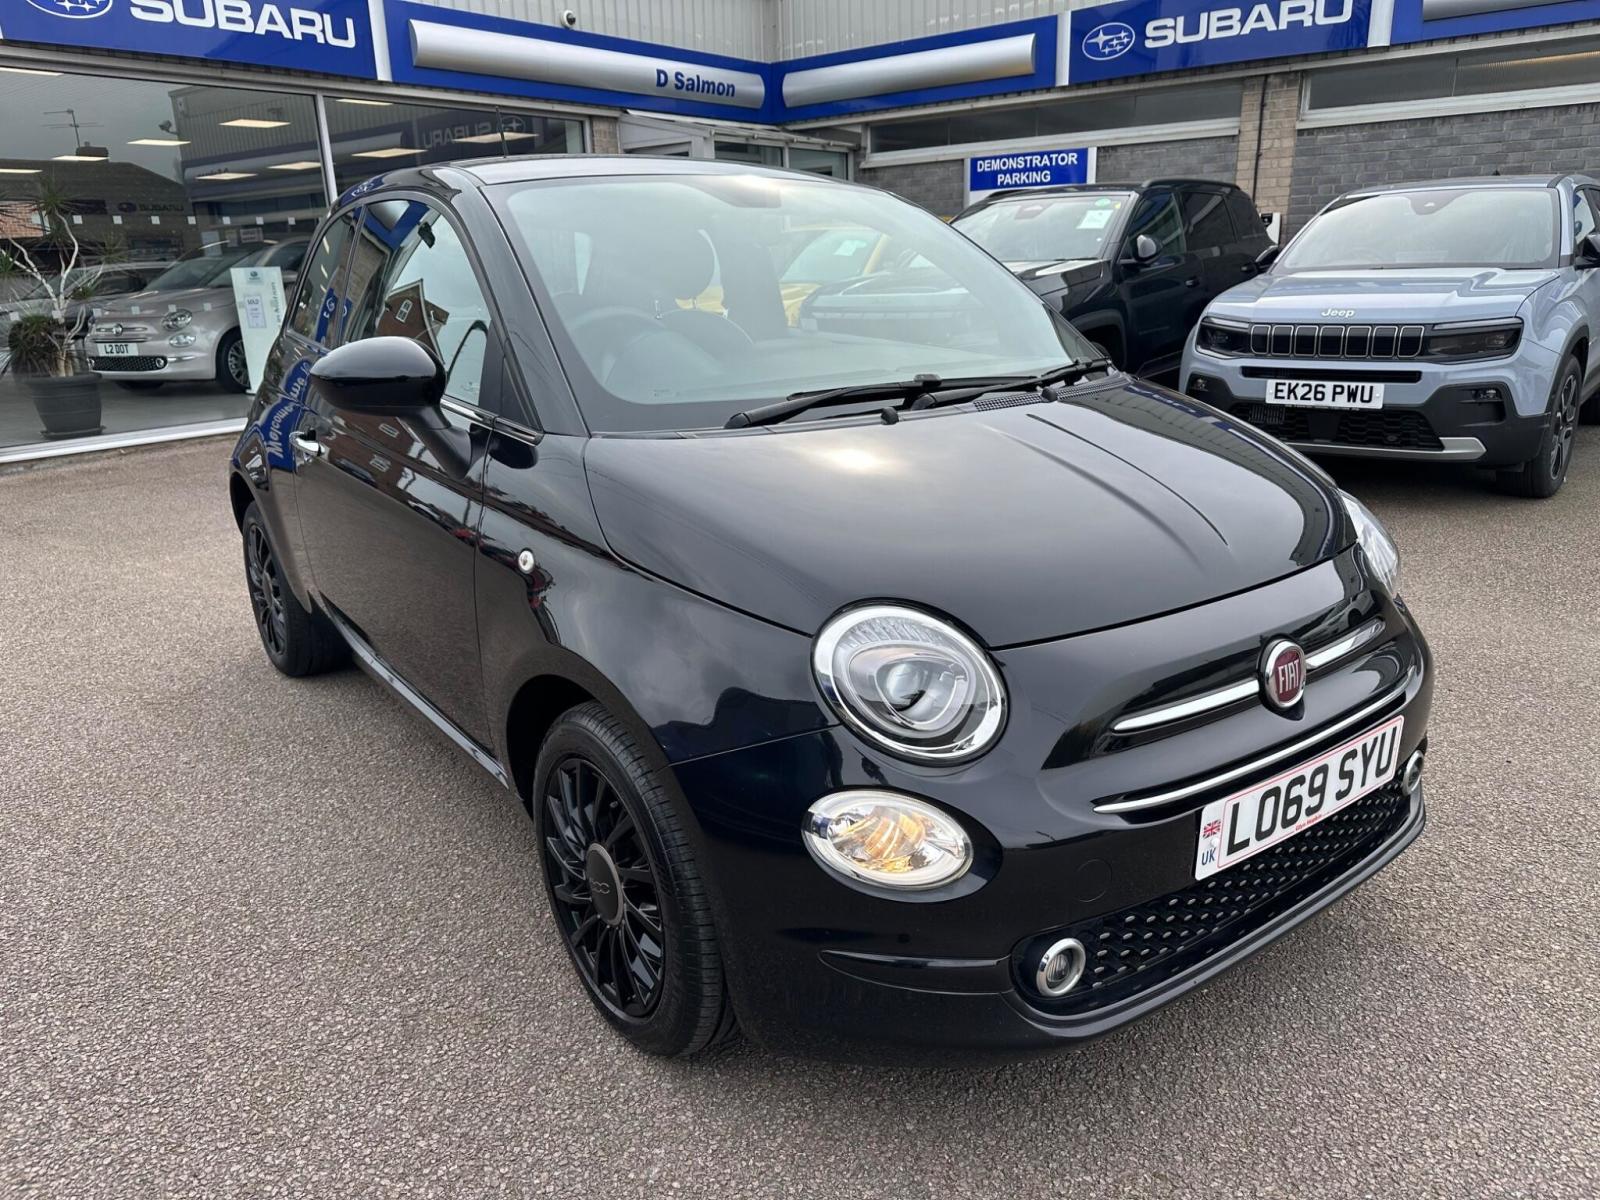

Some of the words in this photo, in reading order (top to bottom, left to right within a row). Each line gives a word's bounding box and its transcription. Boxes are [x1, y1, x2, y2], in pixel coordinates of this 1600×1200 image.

[128, 0, 356, 49] SUBARU
[1144, 0, 1353, 48] SUBARU
[656, 69, 669, 87] D
[674, 72, 736, 97] Salmon
[977, 153, 1078, 172] DEMONSTRATOR
[997, 170, 1051, 186] PARKING
[1321, 308, 1355, 318] Jeep
[1274, 382, 1326, 402] EK26
[1331, 384, 1374, 404] PWU
[1278, 659, 1299, 694] FIAT
[1226, 763, 1329, 857] LO69
[1335, 726, 1398, 801] SYU
[1201, 847, 1216, 866] UK
